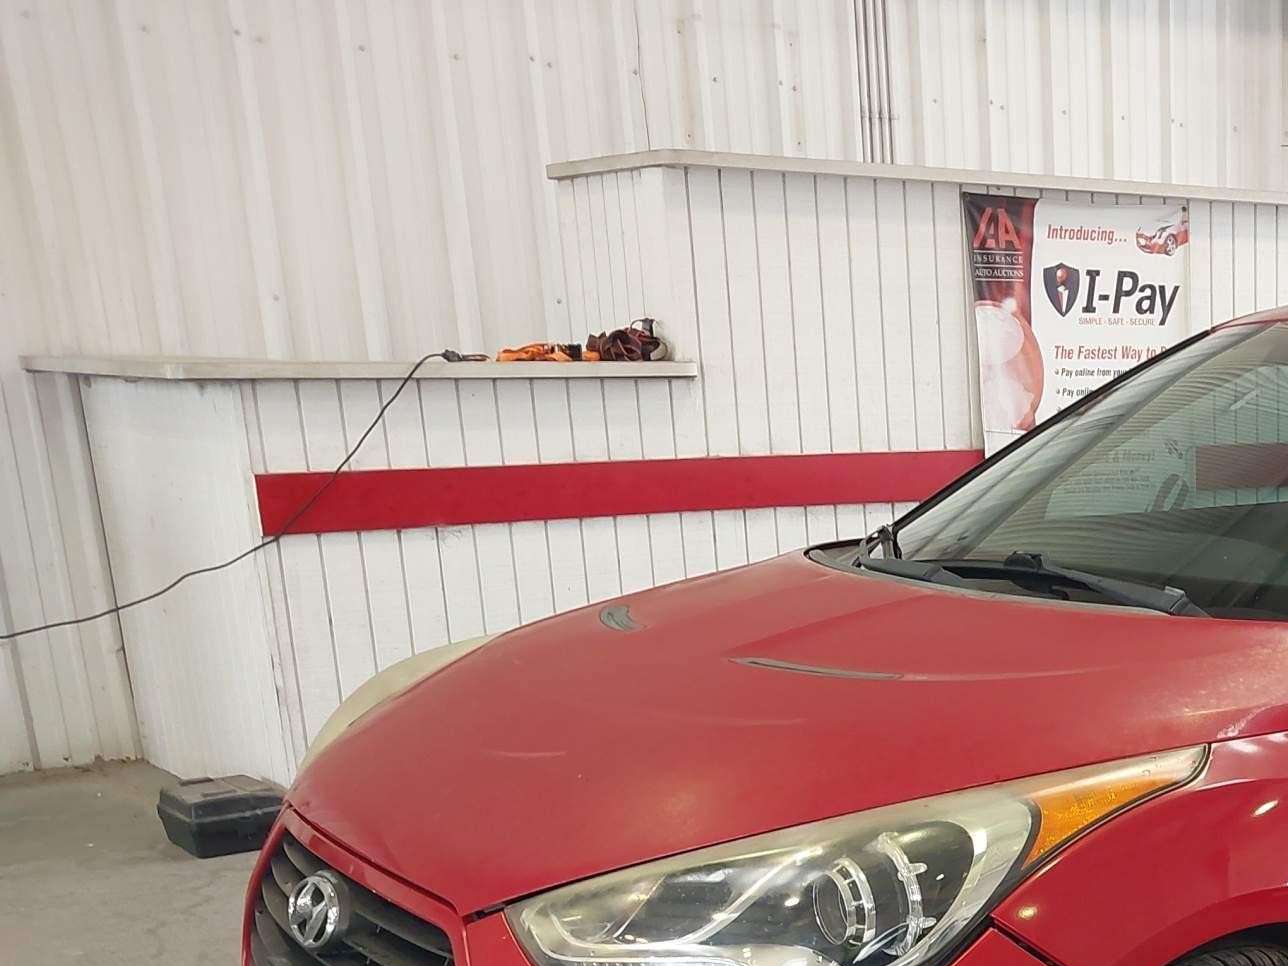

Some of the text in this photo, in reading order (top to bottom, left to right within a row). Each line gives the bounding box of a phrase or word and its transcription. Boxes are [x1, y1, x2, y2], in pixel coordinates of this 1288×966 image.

[1047, 224, 1127, 245] Introducing...
[973, 254, 1024, 265] INSURANCE
[975, 268, 1024, 278] AUTO AUCTIONS
[1081, 269, 1180, 326] I-Pay
[1078, 317, 1102, 325] SIMPLE
[1108, 317, 1124, 326] SAFE
[1129, 318, 1155, 326] SECURE
[1054, 345, 1073, 360] The
[1077, 346, 1118, 360] Fastest
[1121, 346, 1144, 362] Way
[1146, 346, 1157, 359] to
[1061, 368, 1073, 378] Pay
[1074, 368, 1095, 377] online
[1096, 367, 1112, 377] from
[1062, 388, 1074, 398] Pay
